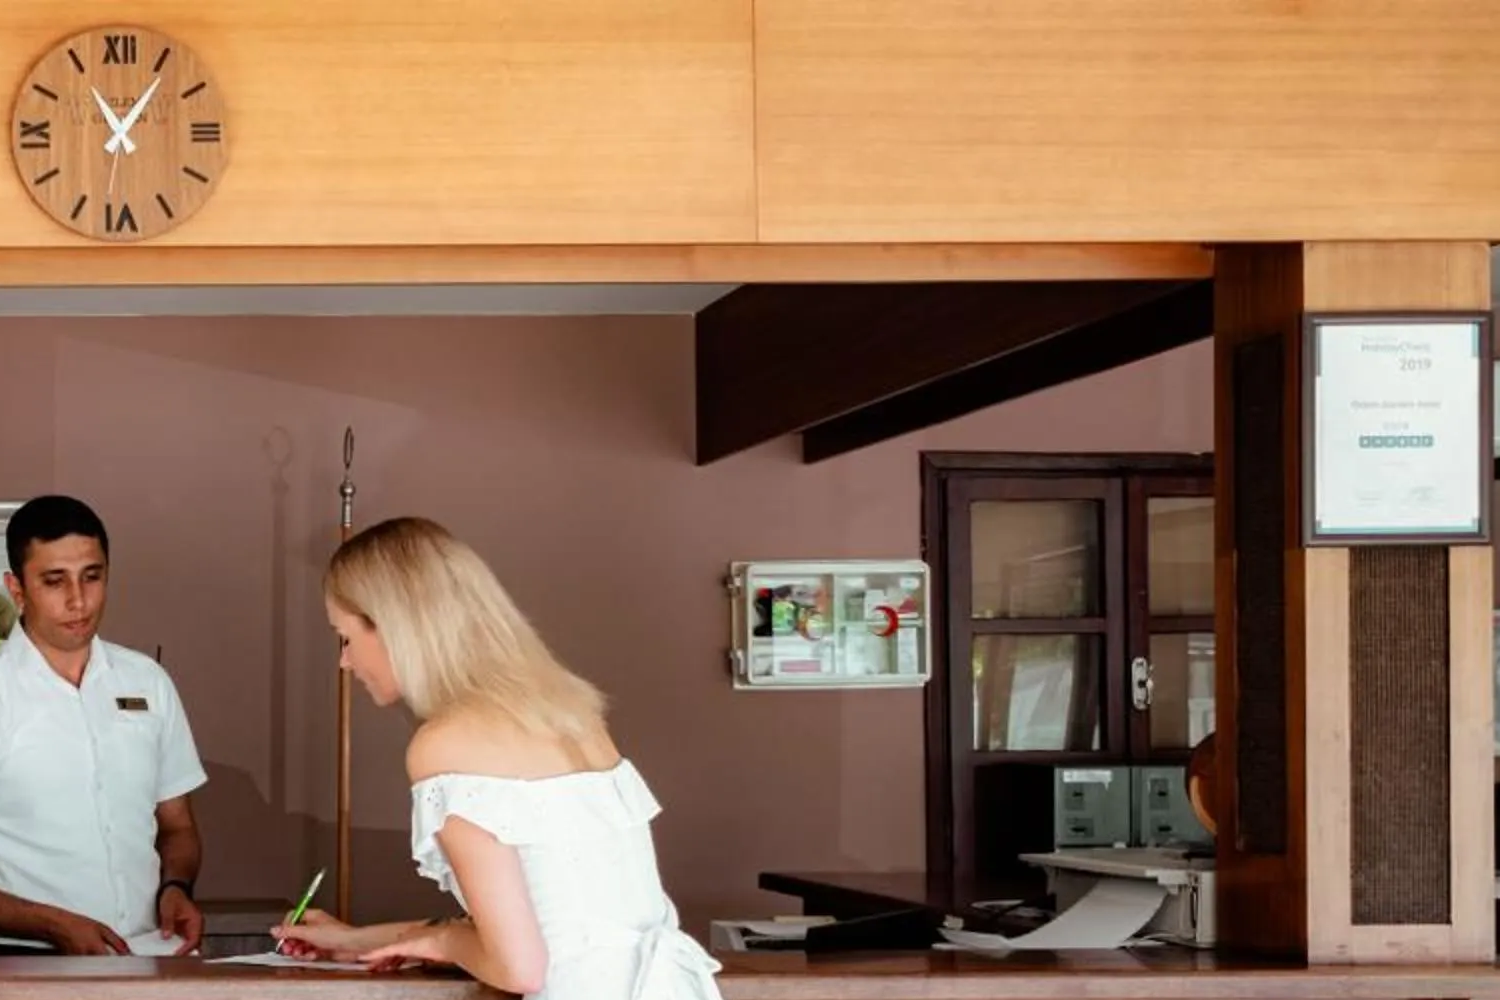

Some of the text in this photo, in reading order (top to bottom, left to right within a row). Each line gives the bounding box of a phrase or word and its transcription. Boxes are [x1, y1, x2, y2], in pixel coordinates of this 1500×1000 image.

[103, 35, 137, 65] XII
[190, 122, 221, 143] III
[1399, 357, 1432, 372] 2019
